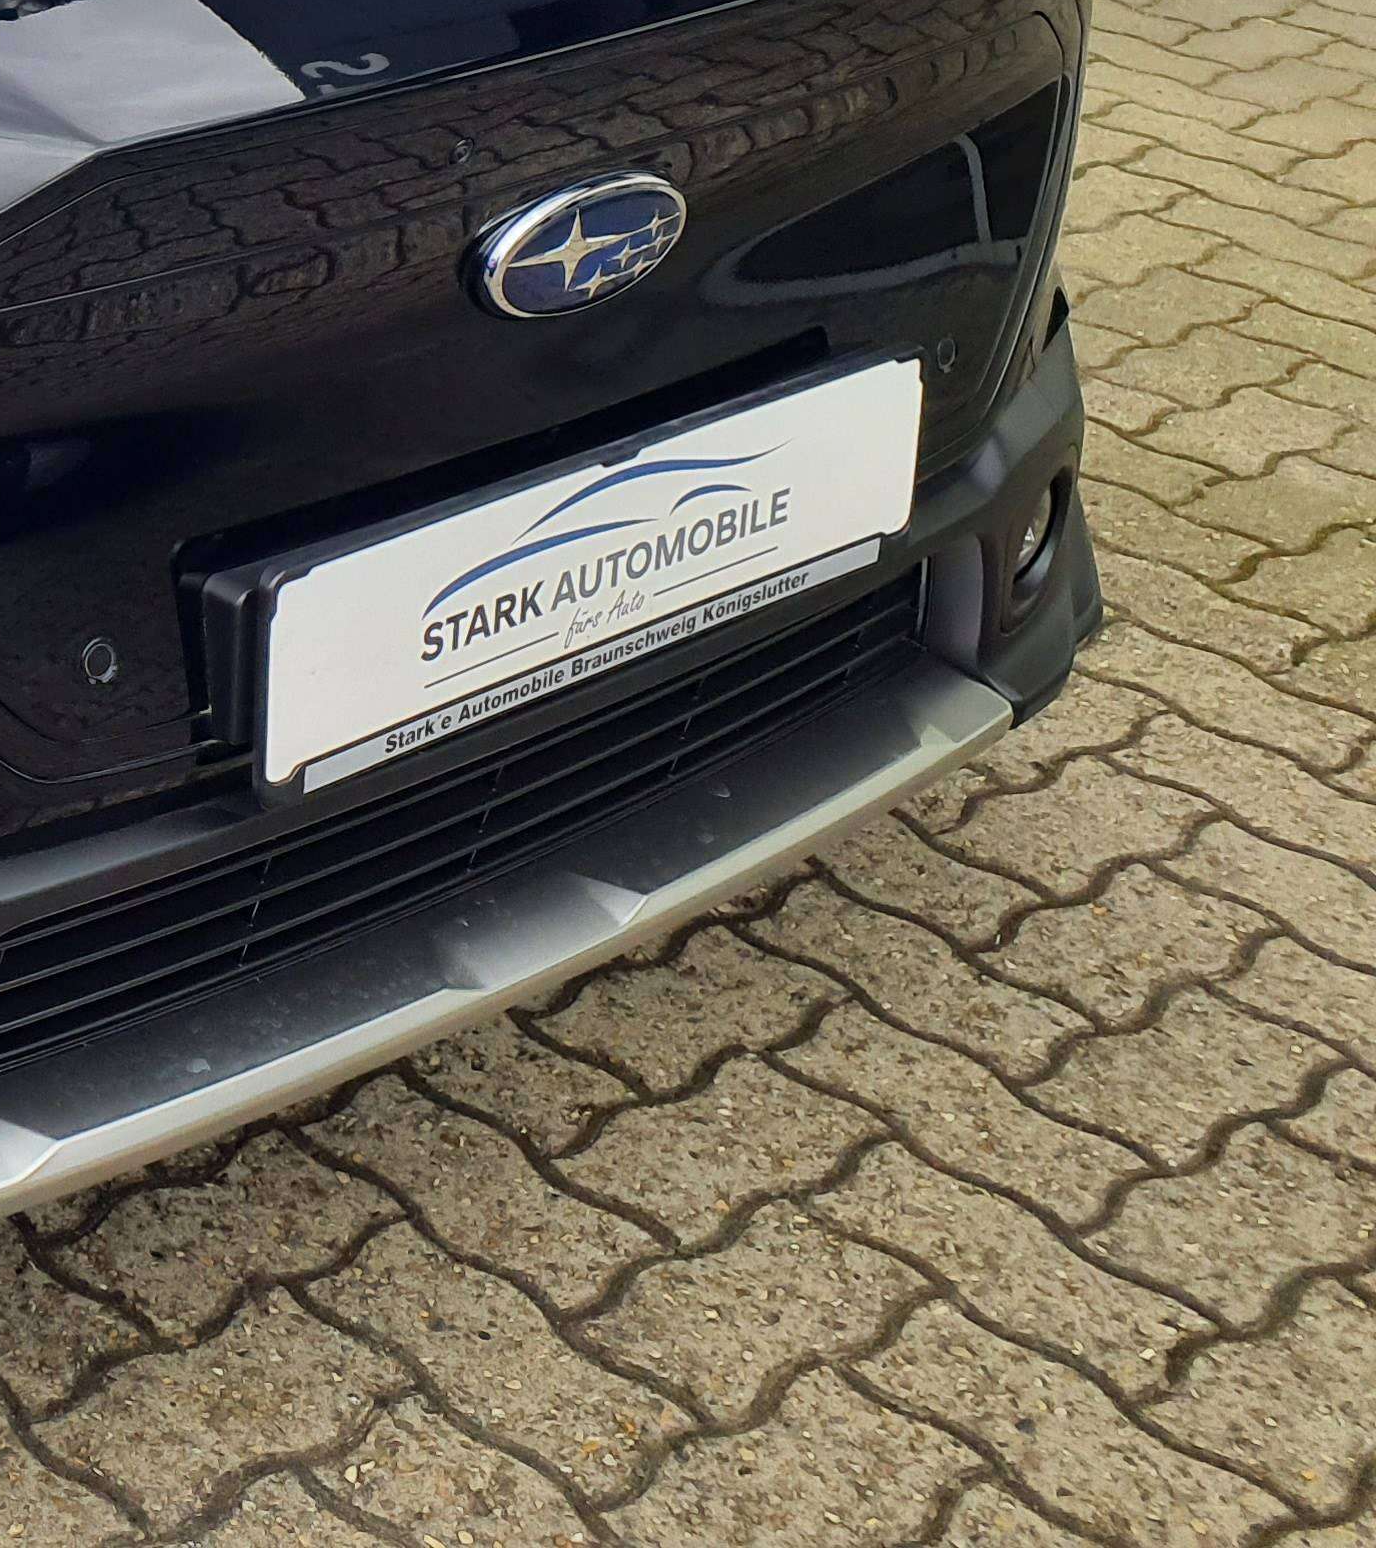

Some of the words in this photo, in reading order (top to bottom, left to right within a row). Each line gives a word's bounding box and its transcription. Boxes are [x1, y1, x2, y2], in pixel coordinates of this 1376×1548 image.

[420, 579, 546, 662] STARK
[549, 487, 791, 612] AUTOMOBILE
[458, 668, 565, 724] Automobile
[570, 614, 698, 678] Braunschweig
[701, 571, 810, 625] Königslutter
